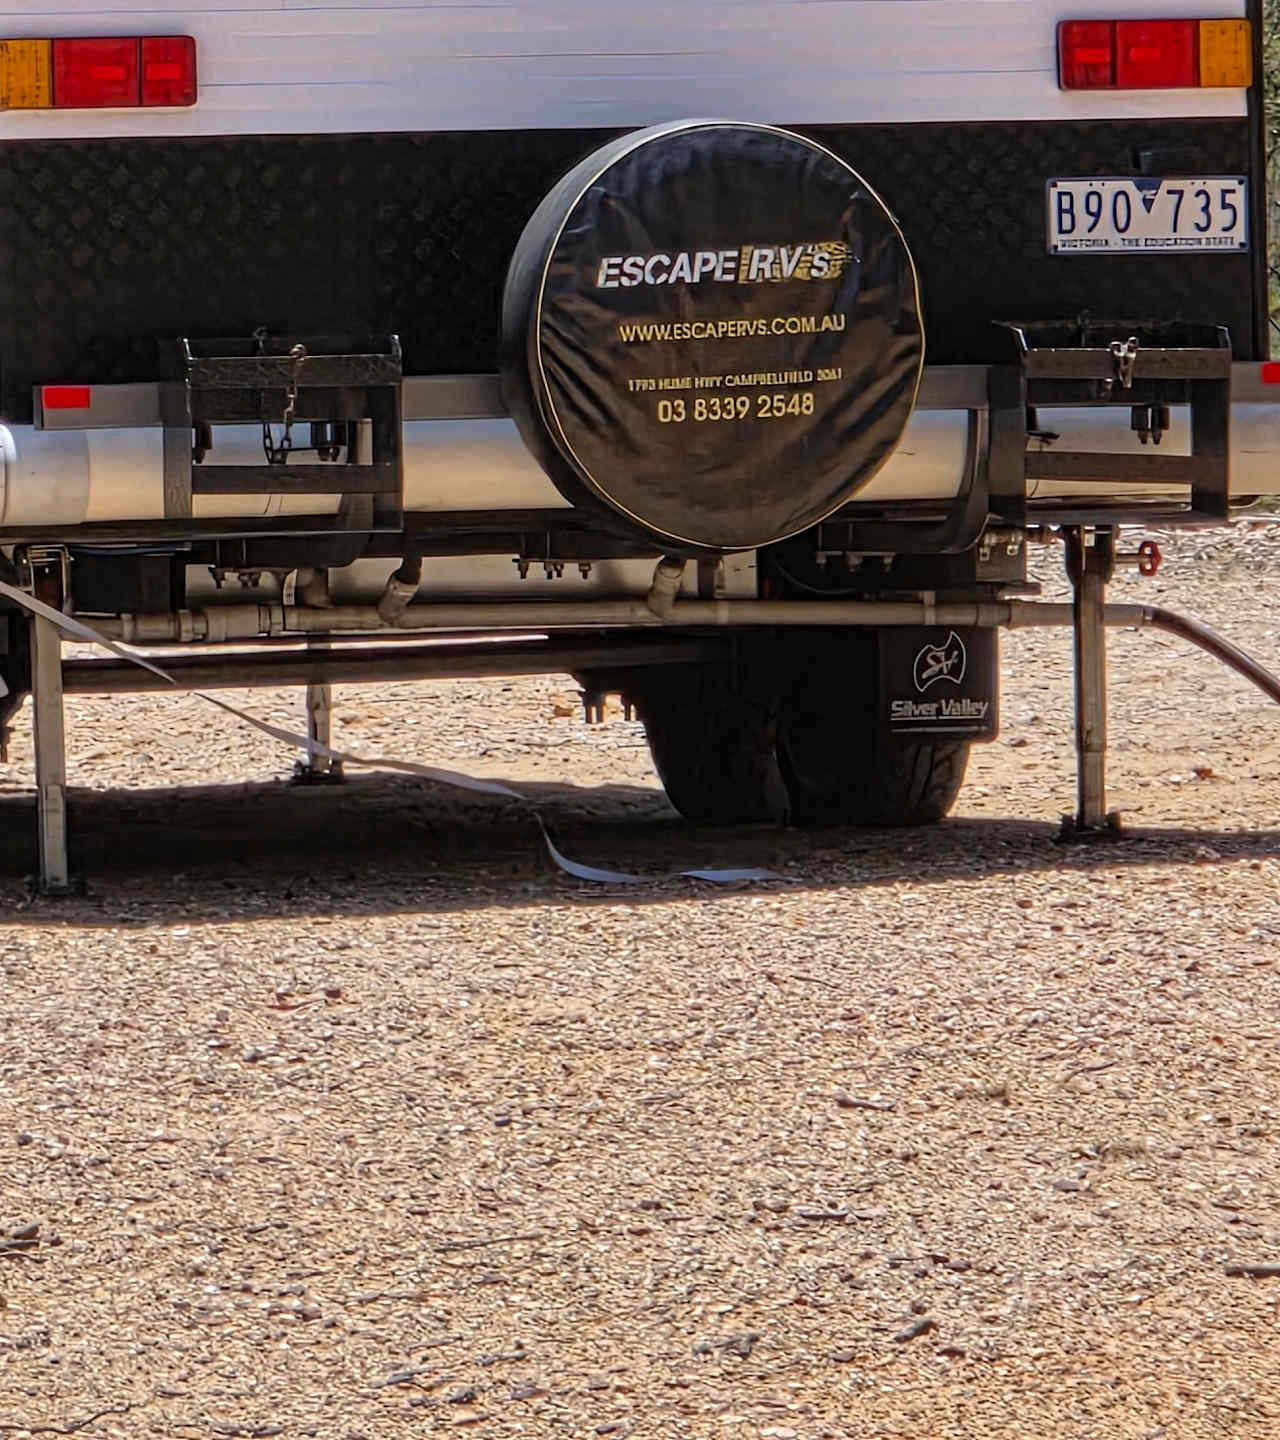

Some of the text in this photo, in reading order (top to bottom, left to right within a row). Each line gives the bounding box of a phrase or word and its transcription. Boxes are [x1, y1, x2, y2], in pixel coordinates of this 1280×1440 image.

[1057, 188, 1238, 235] B90 735
[597, 249, 738, 289] ESCAPE
[619, 314, 845, 343] WWW.ESCAPERVS.COM.AU
[657, 391, 815, 423] 03 8339 2548
[891, 698, 989, 718] Silver Valley
